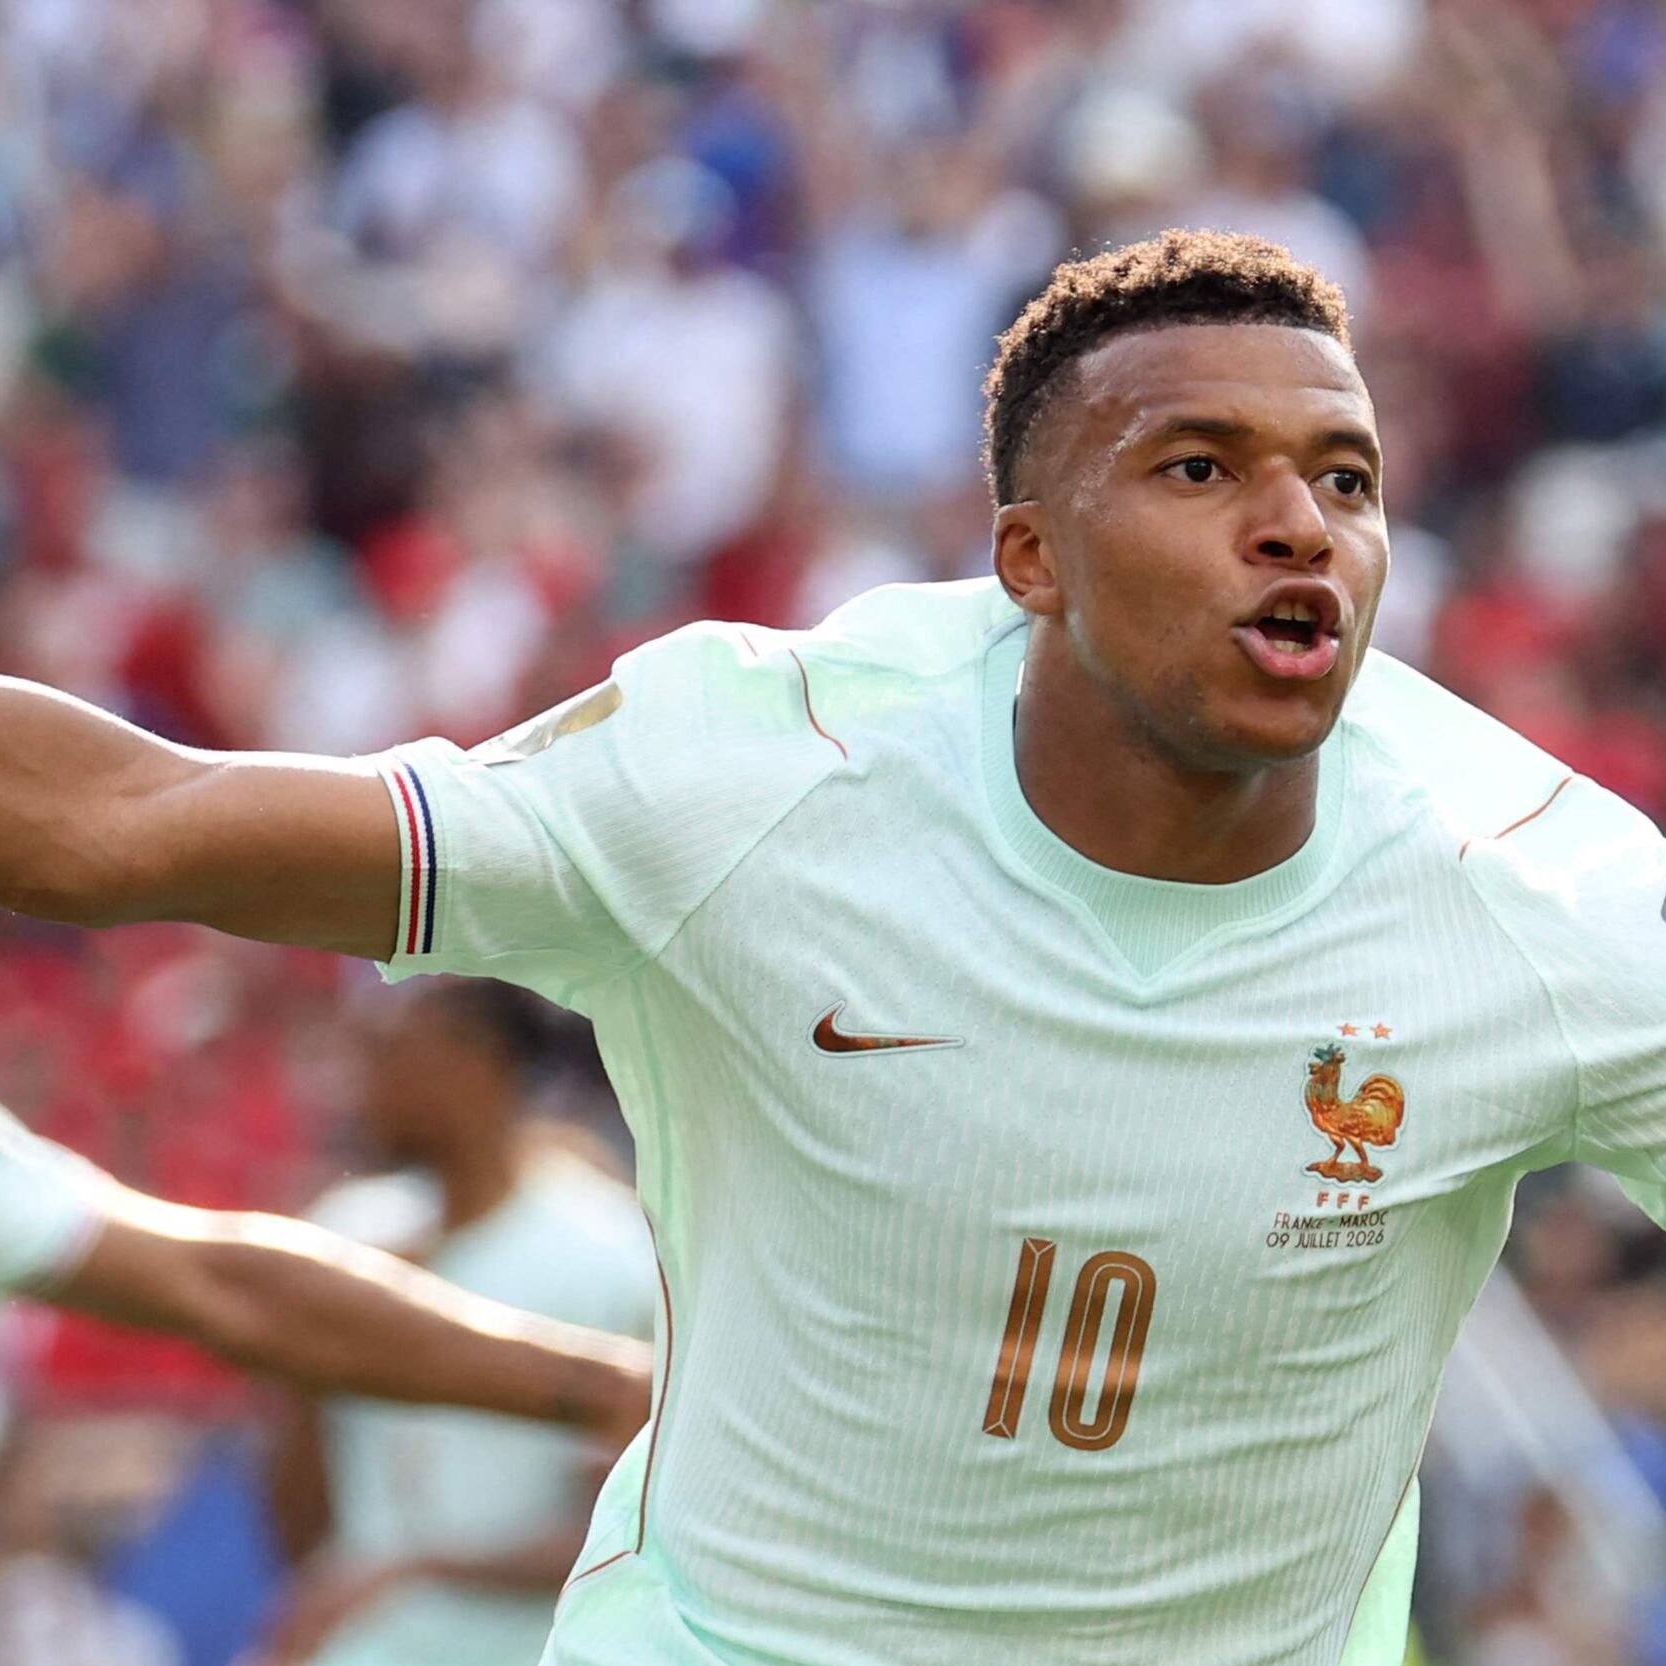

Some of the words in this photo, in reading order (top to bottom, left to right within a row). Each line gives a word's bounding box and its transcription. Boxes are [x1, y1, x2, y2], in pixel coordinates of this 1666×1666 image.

[1340, 1210, 1389, 1228] MAROC
[1266, 1232, 1290, 1248] 09
[1294, 1231, 1341, 1248] JUILLET
[1346, 1228, 1384, 1248] 2026
[982, 1237, 1157, 1451] 10
